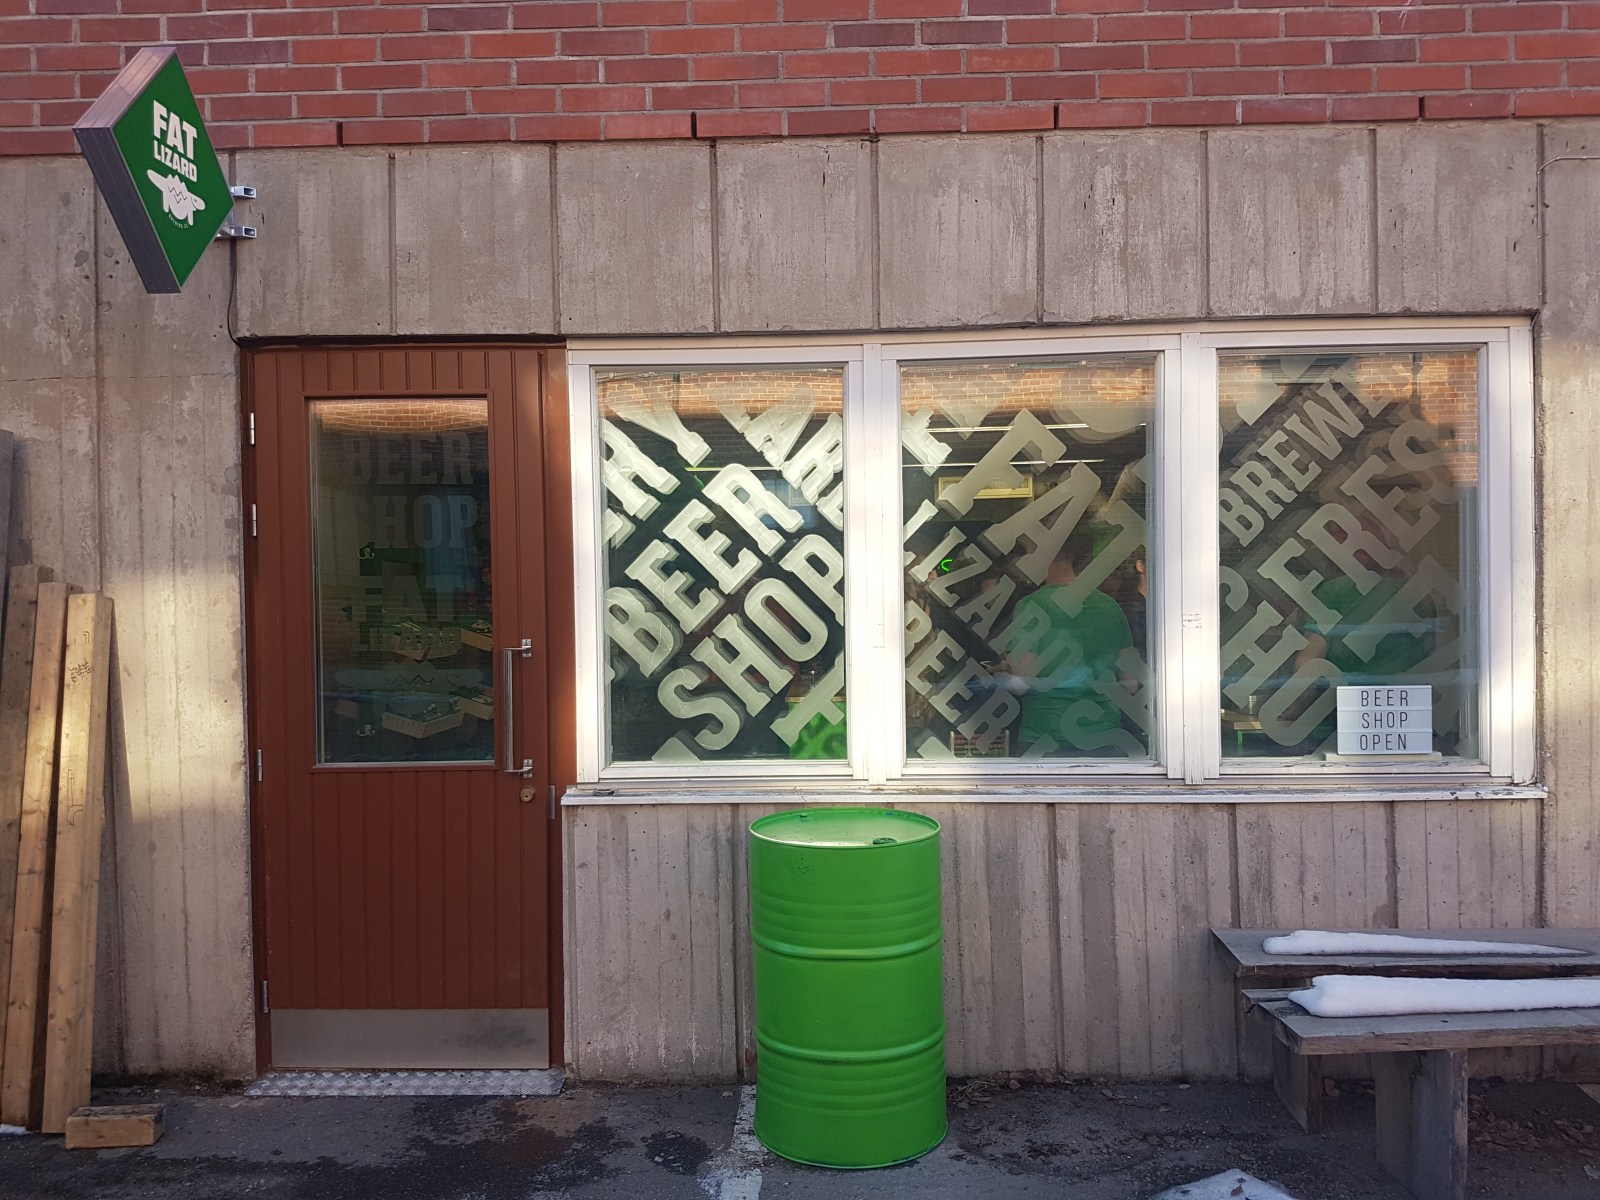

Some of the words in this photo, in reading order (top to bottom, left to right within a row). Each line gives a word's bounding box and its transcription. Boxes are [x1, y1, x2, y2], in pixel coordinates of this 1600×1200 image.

[153, 100, 198, 160] FAT
[153, 140, 198, 182] LIZARD
[345, 432, 474, 485] BEER
[938, 408, 1150, 619] FAT
[604, 463, 806, 678] BEER
[352, 576, 463, 622] FAT
[656, 534, 844, 750] SHOP
[905, 600, 1021, 754] BEER
[1361, 690, 1408, 707] BEER
[1360, 734, 1407, 750] OPEN
[1362, 712, 1408, 729] SHOP
